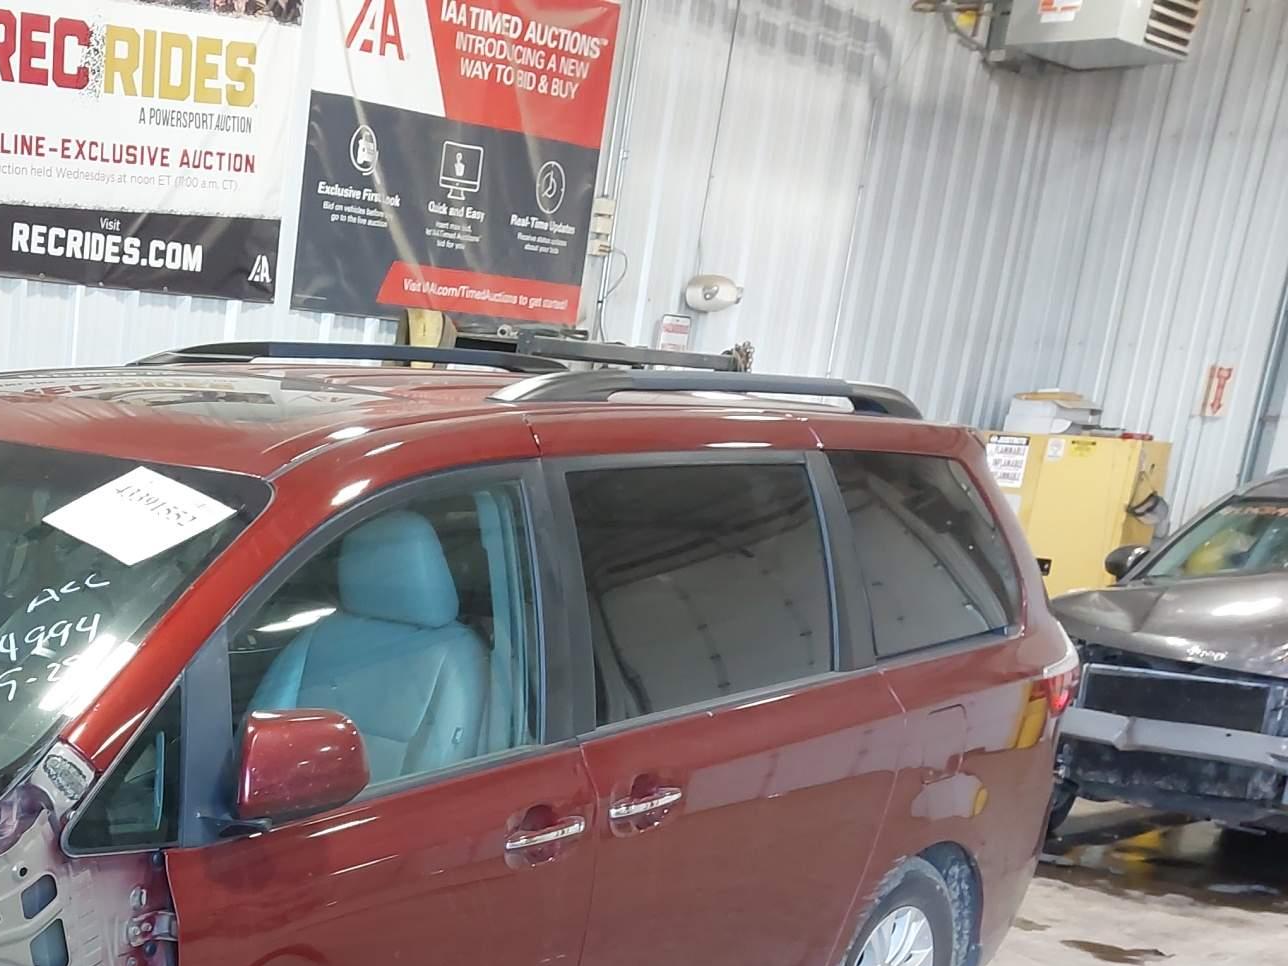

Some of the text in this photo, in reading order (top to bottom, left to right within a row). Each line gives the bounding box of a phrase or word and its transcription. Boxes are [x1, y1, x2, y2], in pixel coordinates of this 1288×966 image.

[441, 0, 467, 26] IAA
[469, 7, 522, 39] TIMED
[456, 32, 589, 79] INTRODUCING A NEW
[461, 57, 578, 99] WAY TO BID & BUY
[139, 107, 252, 133] A POWERSPORT AUCTION
[179, 149, 256, 173] AUCTION
[30, 165, 53, 178] held
[55, 167, 116, 185] Wednesdays
[117, 173, 127, 185] at
[130, 174, 155, 186] noon
[158, 175, 172, 186] ET
[317, 181, 362, 200] Exclusive
[100, 217, 121, 232] Visit
[428, 201, 486, 223] Quick and Easy
[510, 214, 548, 230] Real-Time
[12, 221, 203, 273] RECRIDES.COM
[403, 279, 421, 294] Visit
[519, 295, 528, 306] to
[529, 297, 542, 309] get
